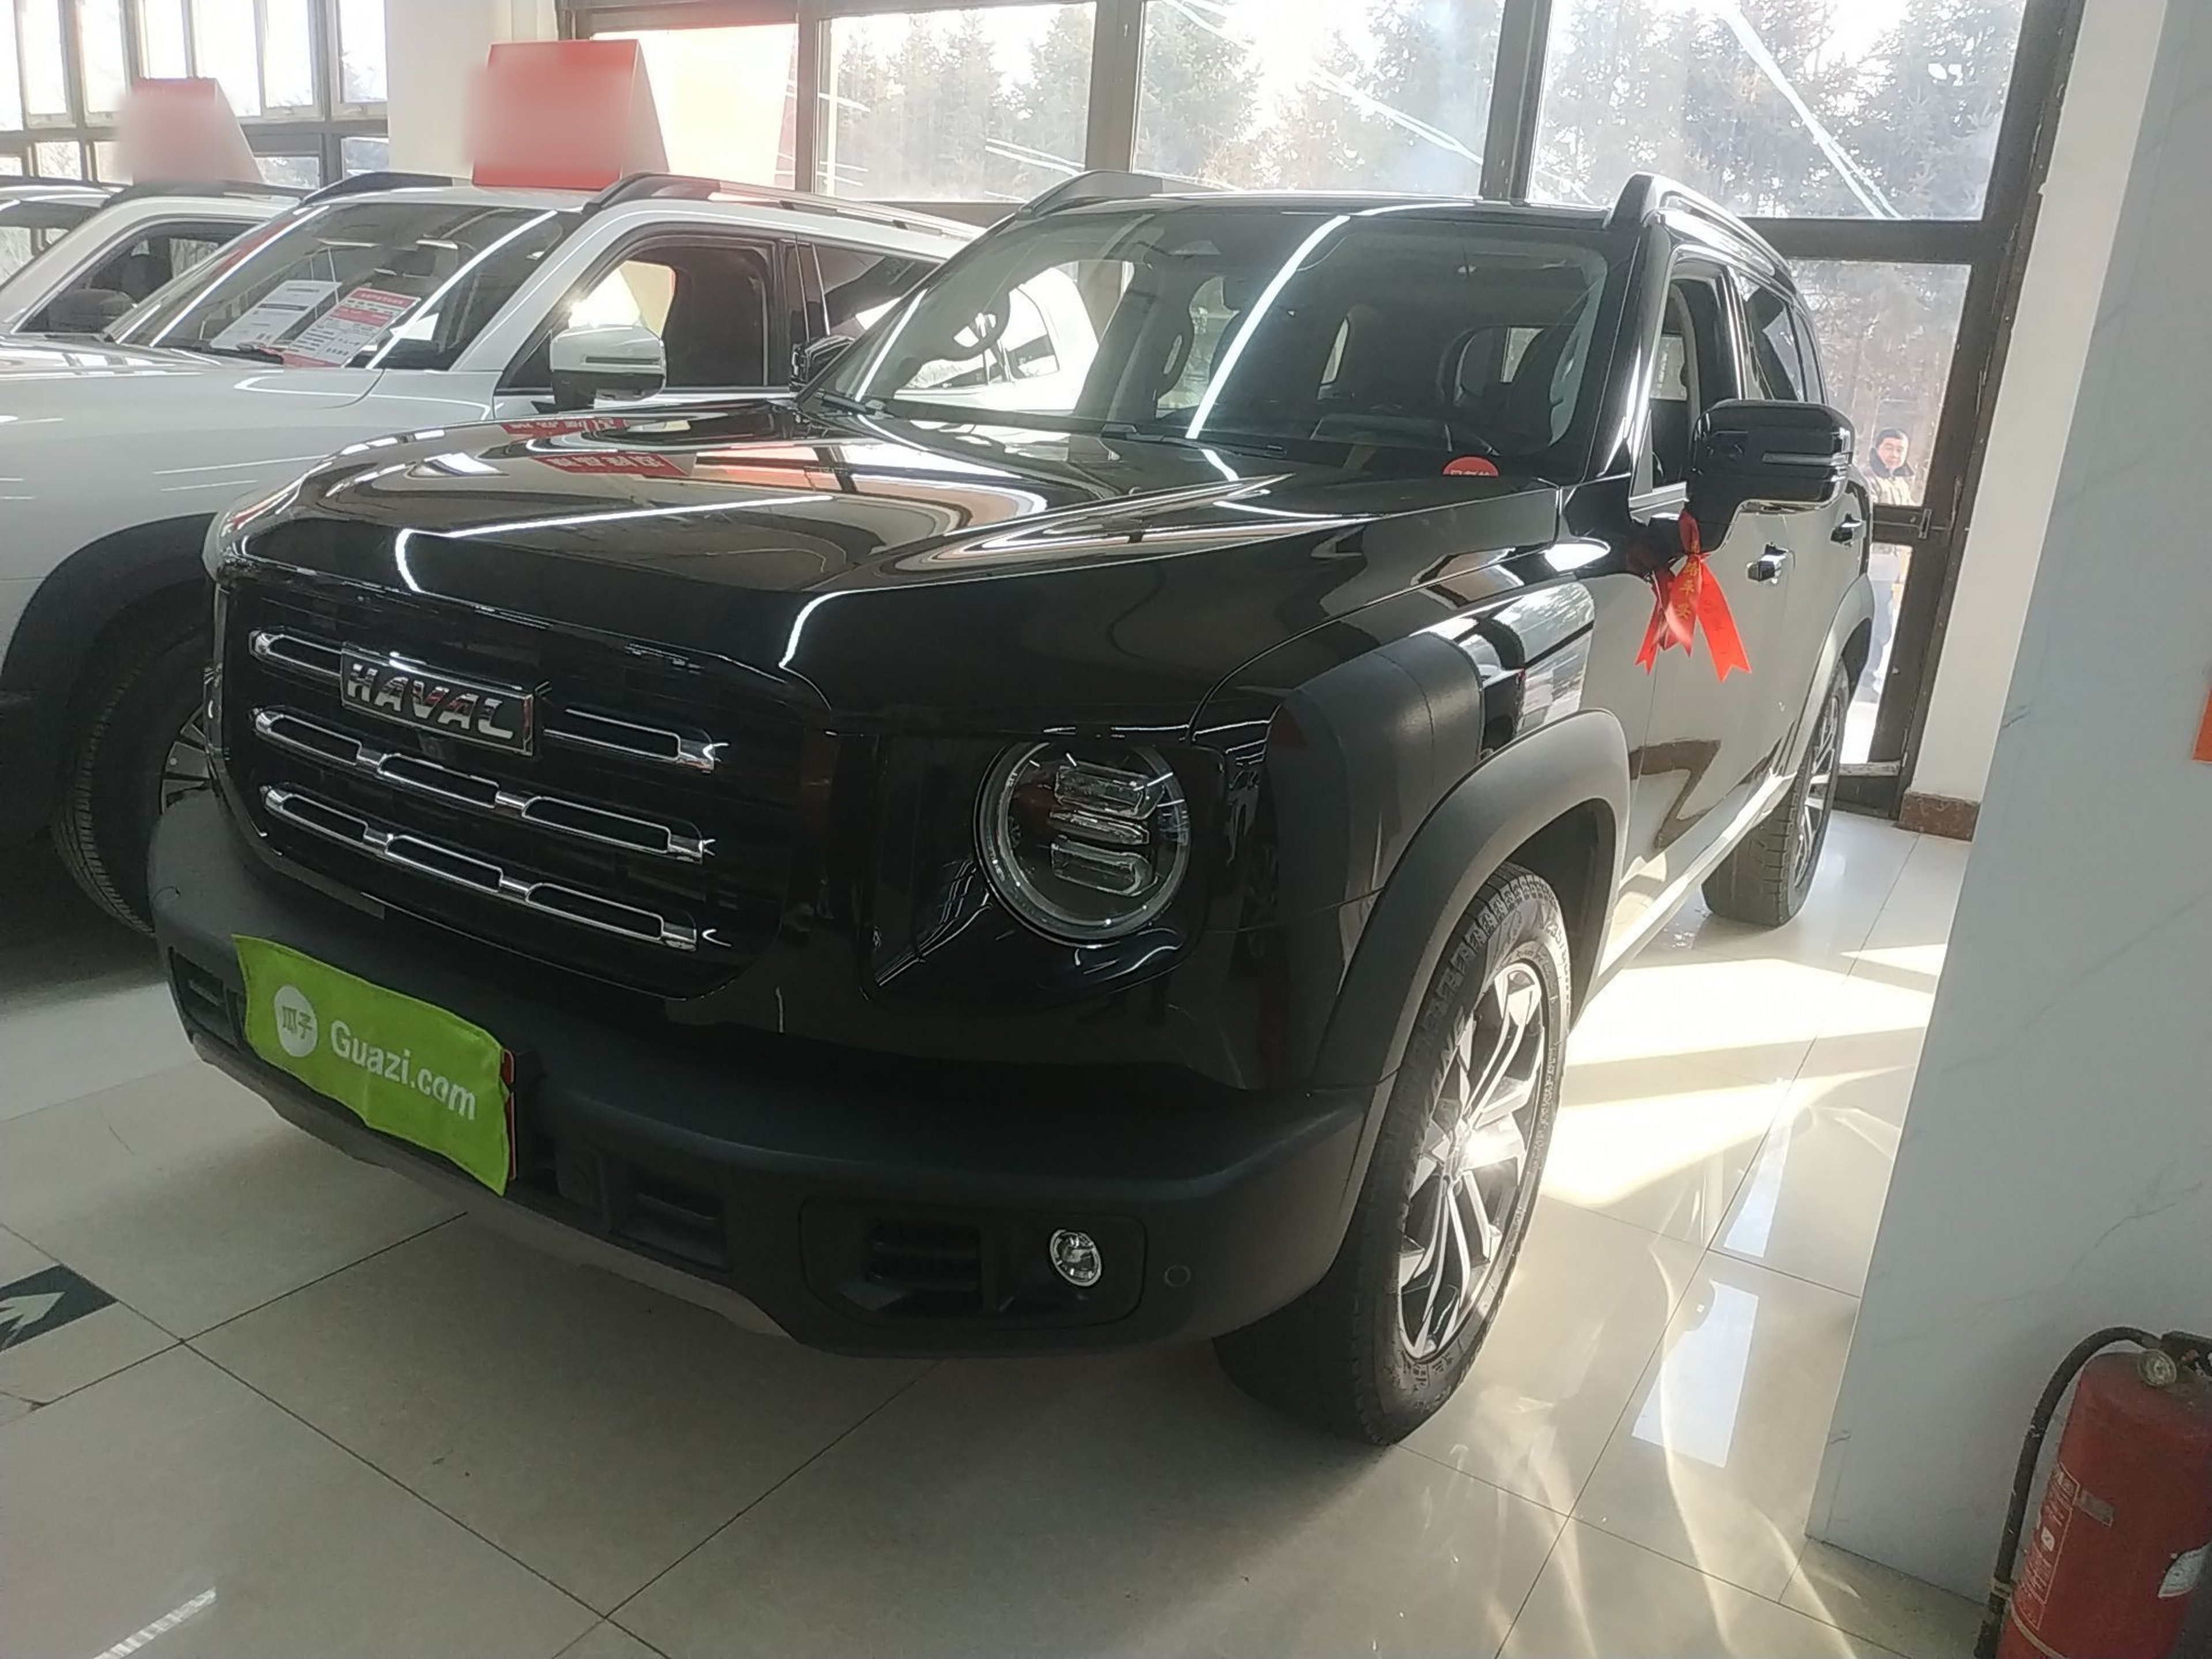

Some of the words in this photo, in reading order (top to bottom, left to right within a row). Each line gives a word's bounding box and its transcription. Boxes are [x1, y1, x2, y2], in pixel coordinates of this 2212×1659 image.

[347, 664, 513, 739] HAVAL
[282, 1006, 313, 1040] 瓜子
[331, 1021, 476, 1120] Guazi.com
